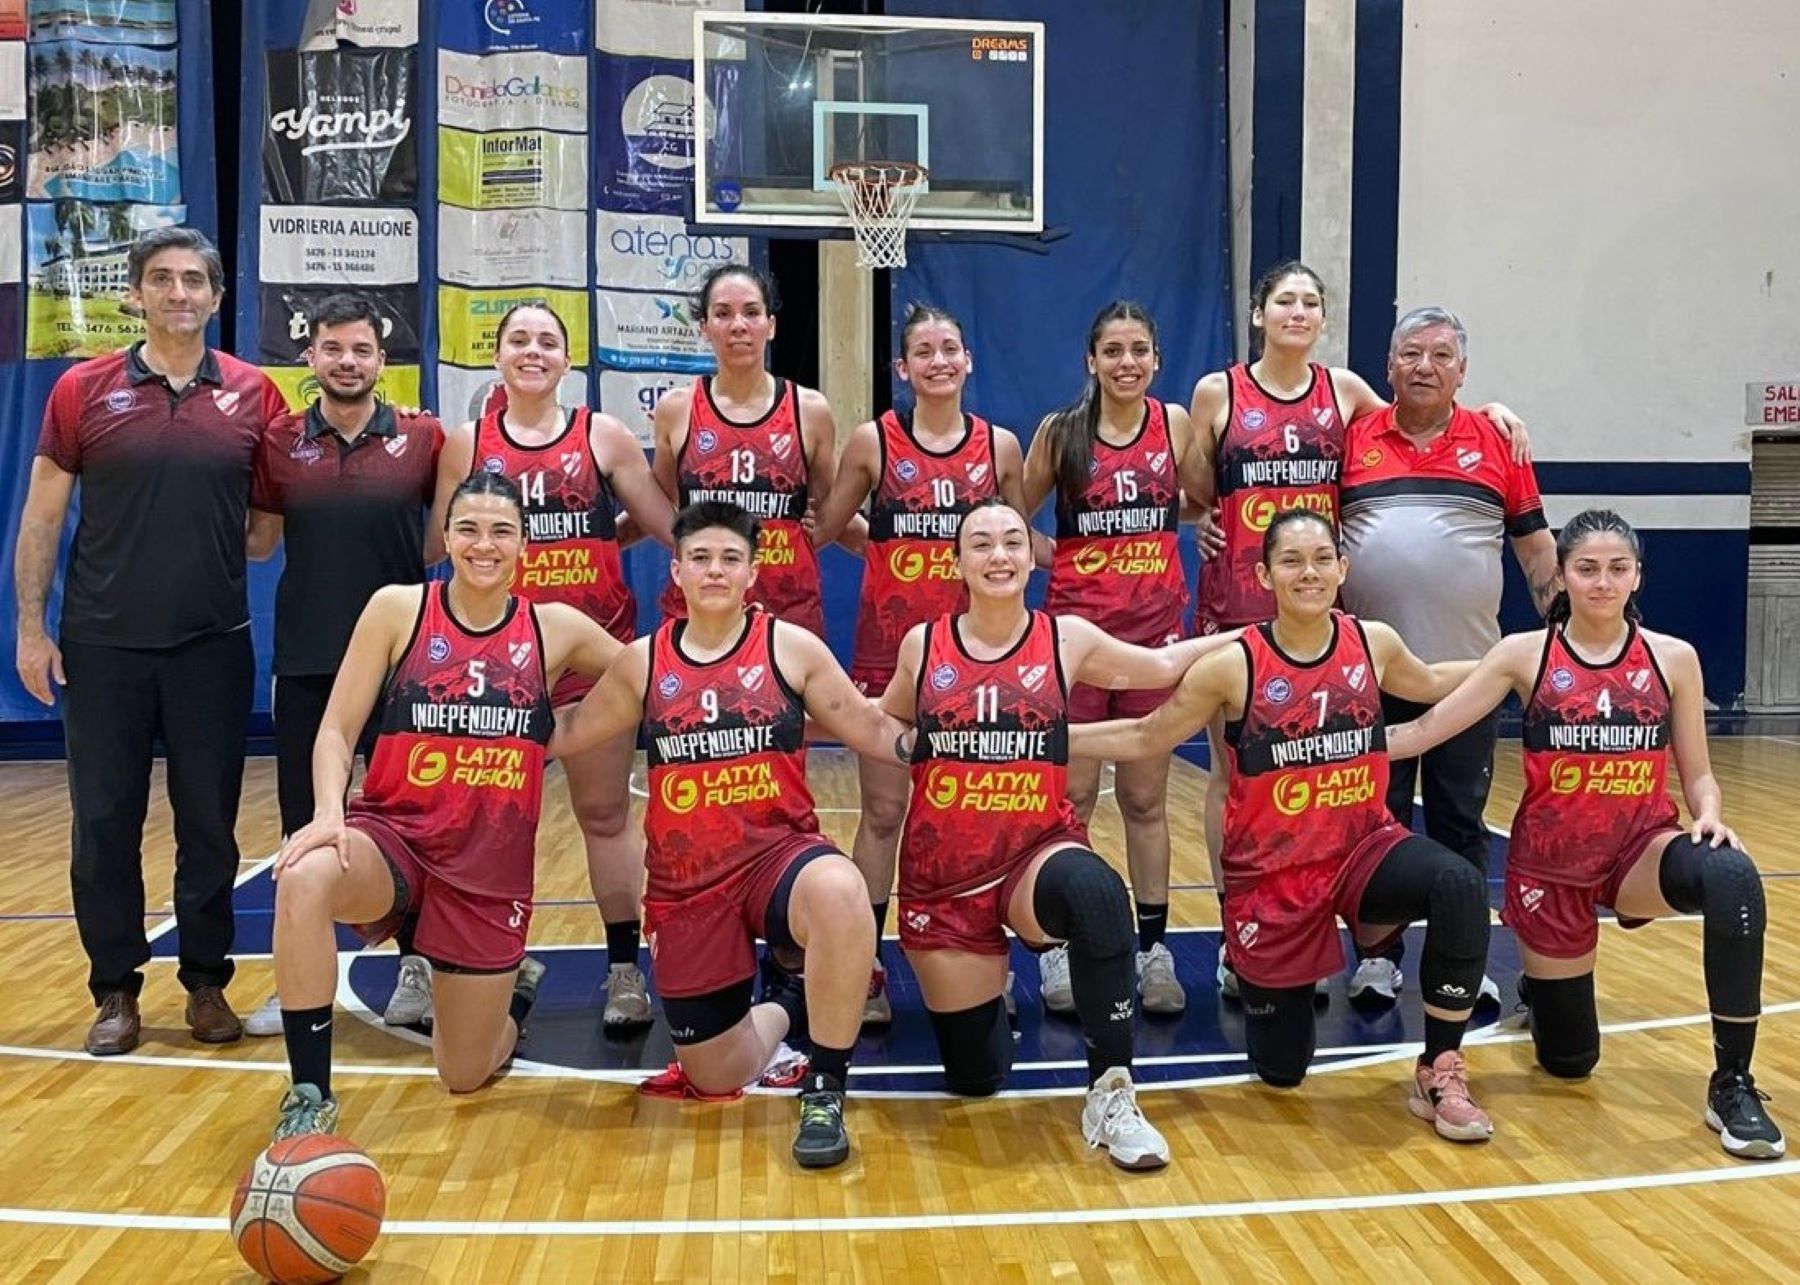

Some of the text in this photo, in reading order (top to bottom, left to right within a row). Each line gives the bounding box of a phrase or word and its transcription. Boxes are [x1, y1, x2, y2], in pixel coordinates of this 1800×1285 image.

[268, 218, 413, 237] VIDRIERIA ALLIONE
[610, 223, 733, 260] atenas
[305, 247, 326, 258] 3476
[86, 324, 112, 334] 3476
[617, 324, 659, 335] MARIANO
[661, 326, 695, 338] ARTAZA
[1764, 385, 1800, 401] SAL
[1283, 424, 1300, 454] 6
[730, 449, 756, 484] 13
[518, 471, 545, 507] 14
[931, 478, 956, 508] 10
[1113, 470, 1138, 503] 15
[522, 548, 590, 568] LATYN
[522, 563, 598, 588] FUSIÓN
[467, 660, 486, 698] 5
[701, 689, 719, 723] 9
[975, 685, 998, 723] 11
[1311, 690, 1329, 728] 7
[1596, 688, 1612, 719] 4
[412, 702, 532, 737] INDEPENDIENTE
[655, 725, 774, 764] INDEPENDIENTE
[928, 730, 1047, 760] INDEPENDIENTE
[1549, 724, 1660, 751] INDEPENDIENTE
[455, 745, 524, 768] LATYN
[1588, 760, 1654, 777] LATYN
[451, 765, 527, 790] FUSIÓN
[702, 762, 773, 787] LATYN
[965, 770, 1042, 791] LATYN
[704, 778, 782, 807] FUSIÓN
[960, 788, 1048, 813] FUSIÓN
